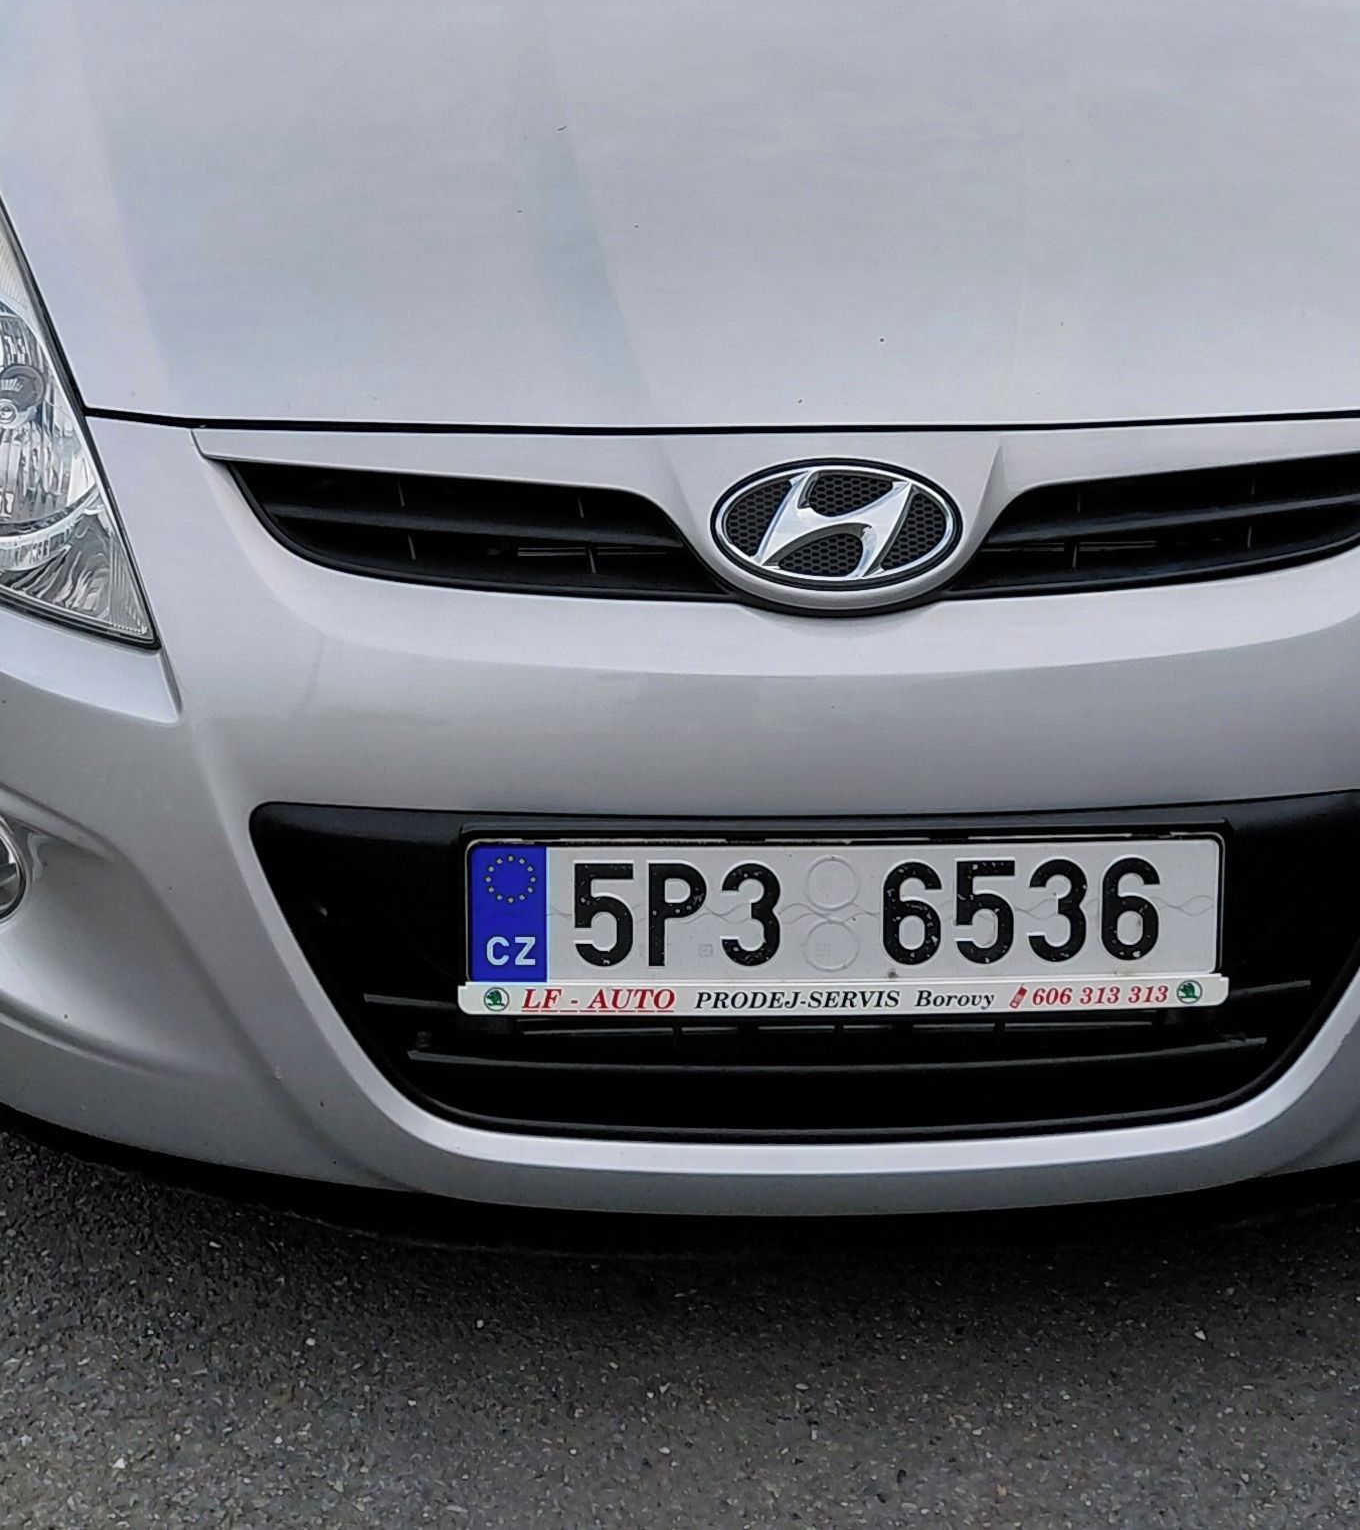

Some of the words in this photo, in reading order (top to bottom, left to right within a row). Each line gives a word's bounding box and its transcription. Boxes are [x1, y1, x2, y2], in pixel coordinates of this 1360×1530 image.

[573, 862, 782, 968] 5P3
[881, 857, 1161, 967] 6536
[485, 935, 537, 967] CZ
[522, 988, 562, 1011] LF
[589, 988, 675, 1011] AUTO
[694, 990, 900, 1010] PRODEJ-SERVIS
[915, 989, 995, 1009] Borovy
[1031, 986, 1072, 1006] 606
[1079, 986, 1120, 1005] 313
[1127, 984, 1169, 1004] 313
